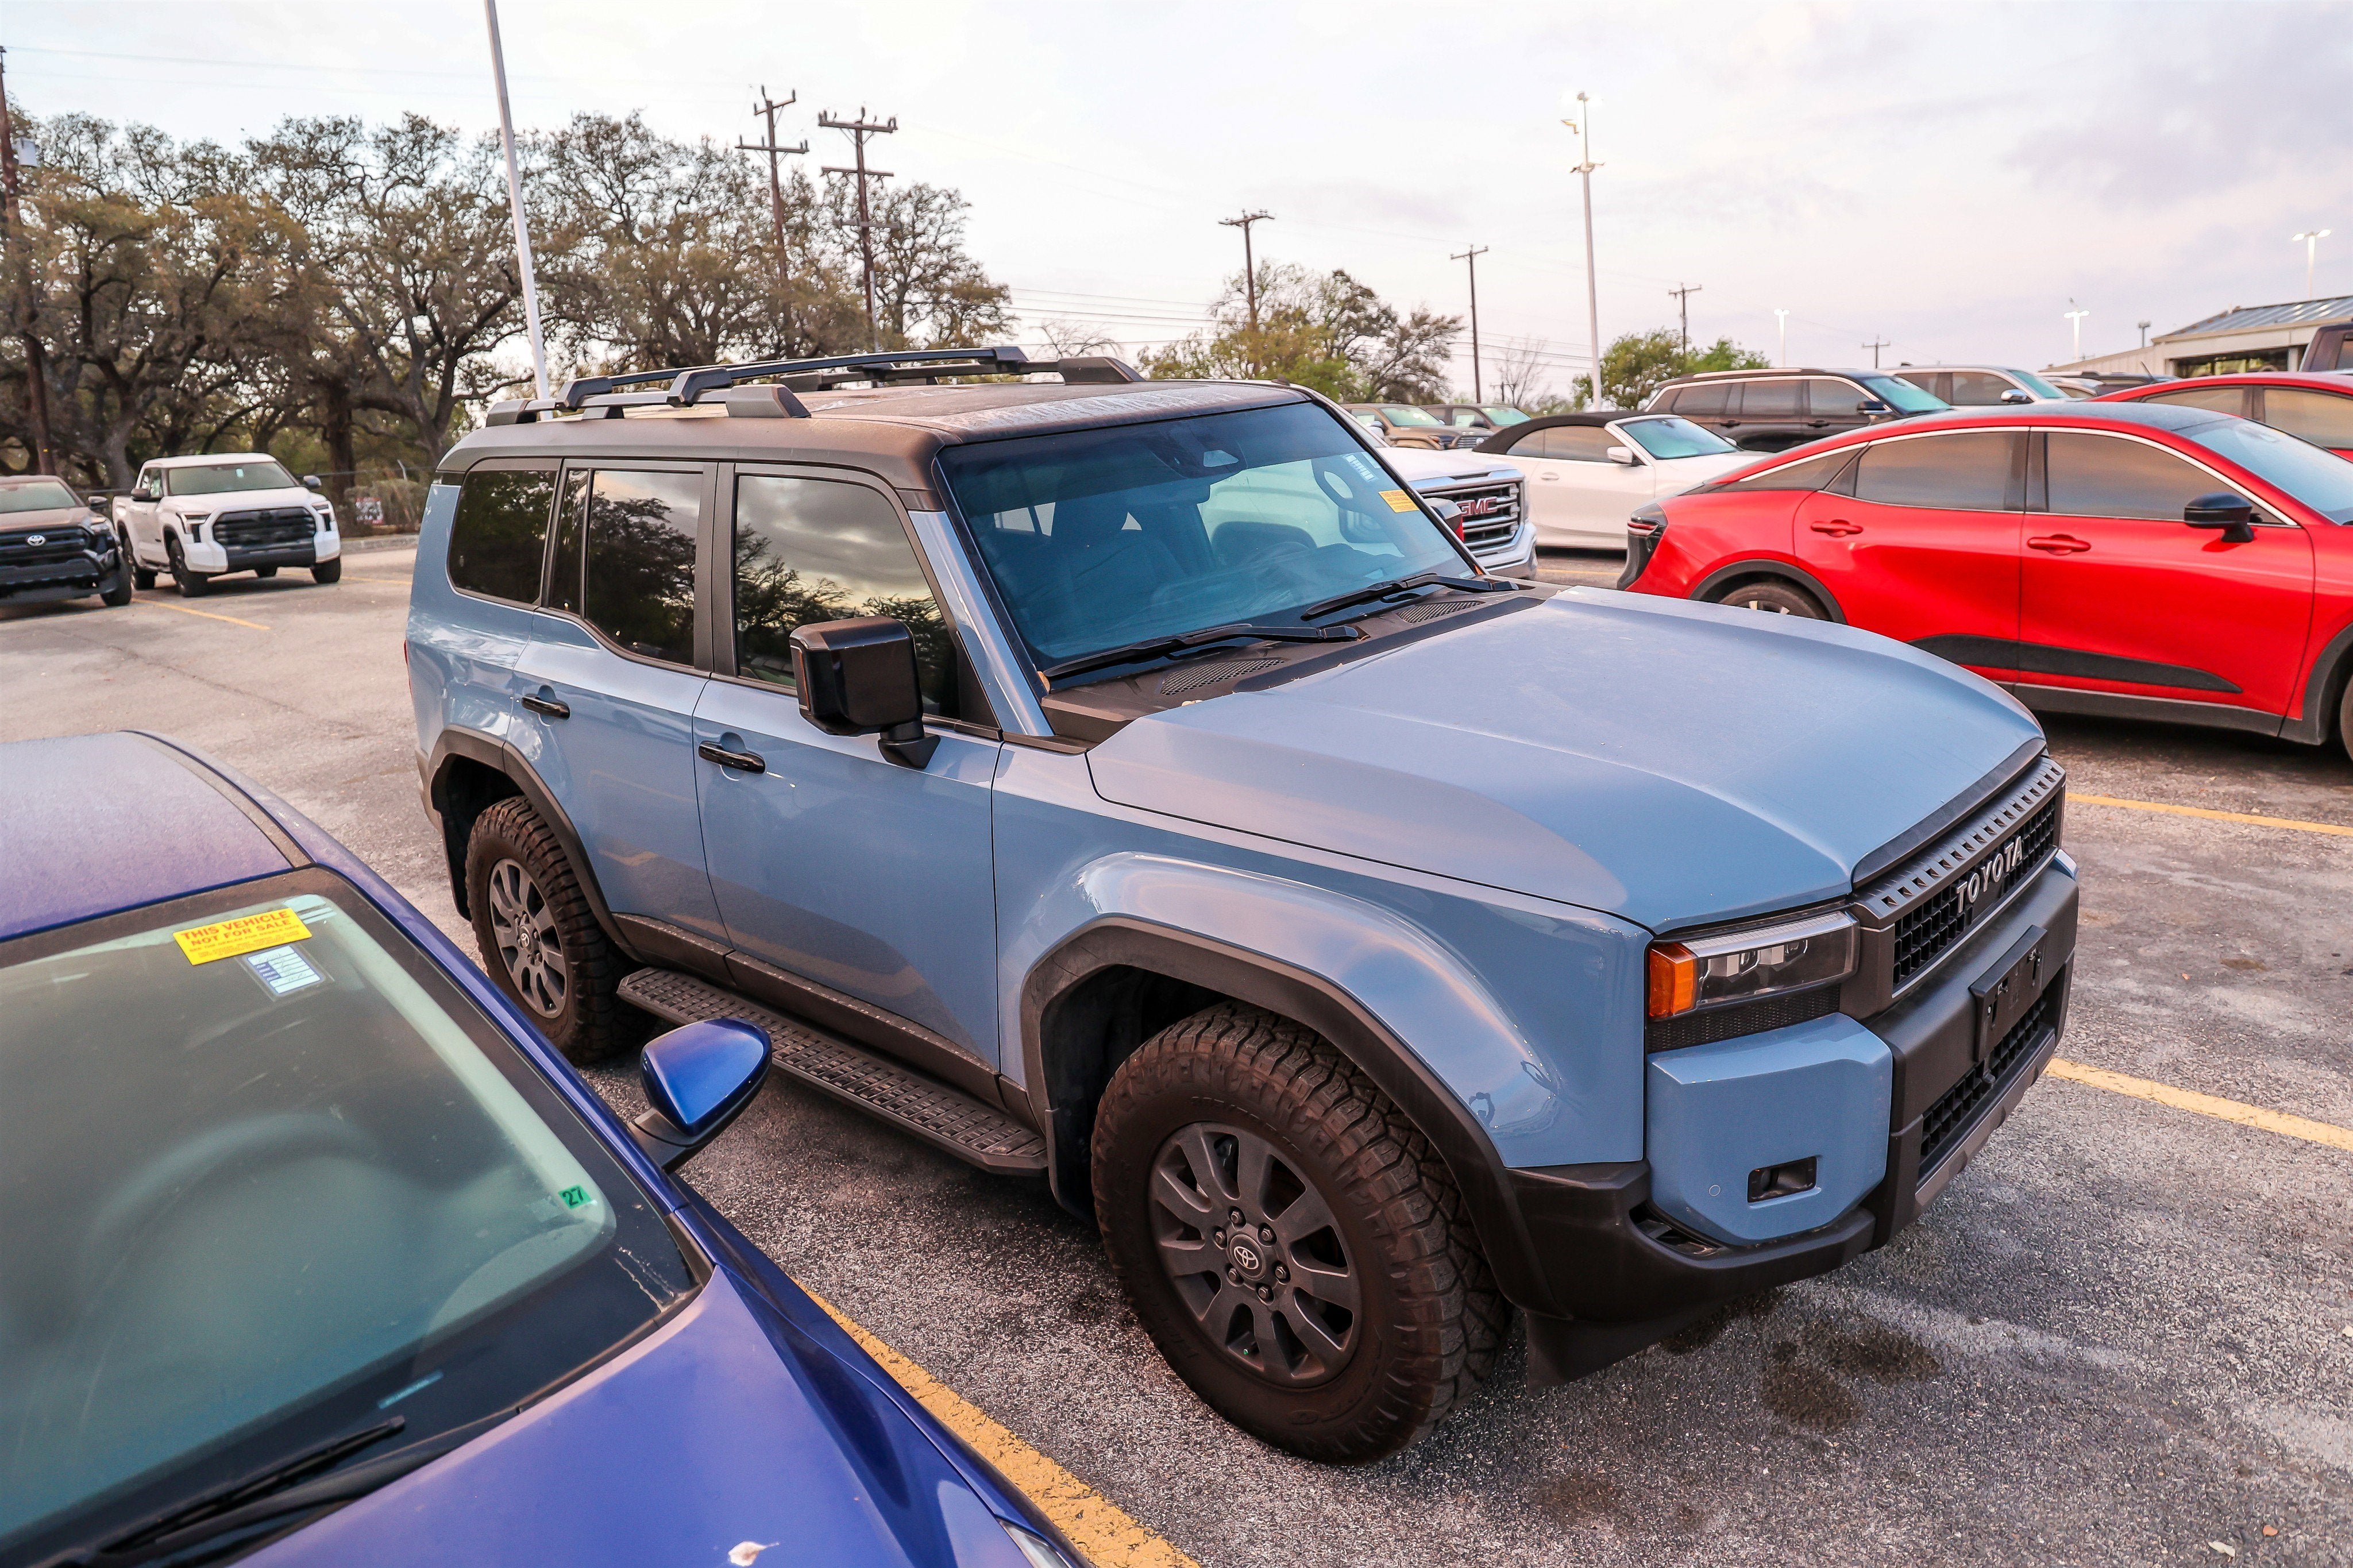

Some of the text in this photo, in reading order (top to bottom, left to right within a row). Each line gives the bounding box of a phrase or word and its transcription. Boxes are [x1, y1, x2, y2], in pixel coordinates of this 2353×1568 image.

[1456, 496, 1497, 516] GMC
[1956, 836, 2023, 913] TOYOTA
[180, 911, 291, 940] THIS VEHICLE
[191, 920, 292, 946] NOT FOR SALE
[562, 1187, 584, 1206] 27
